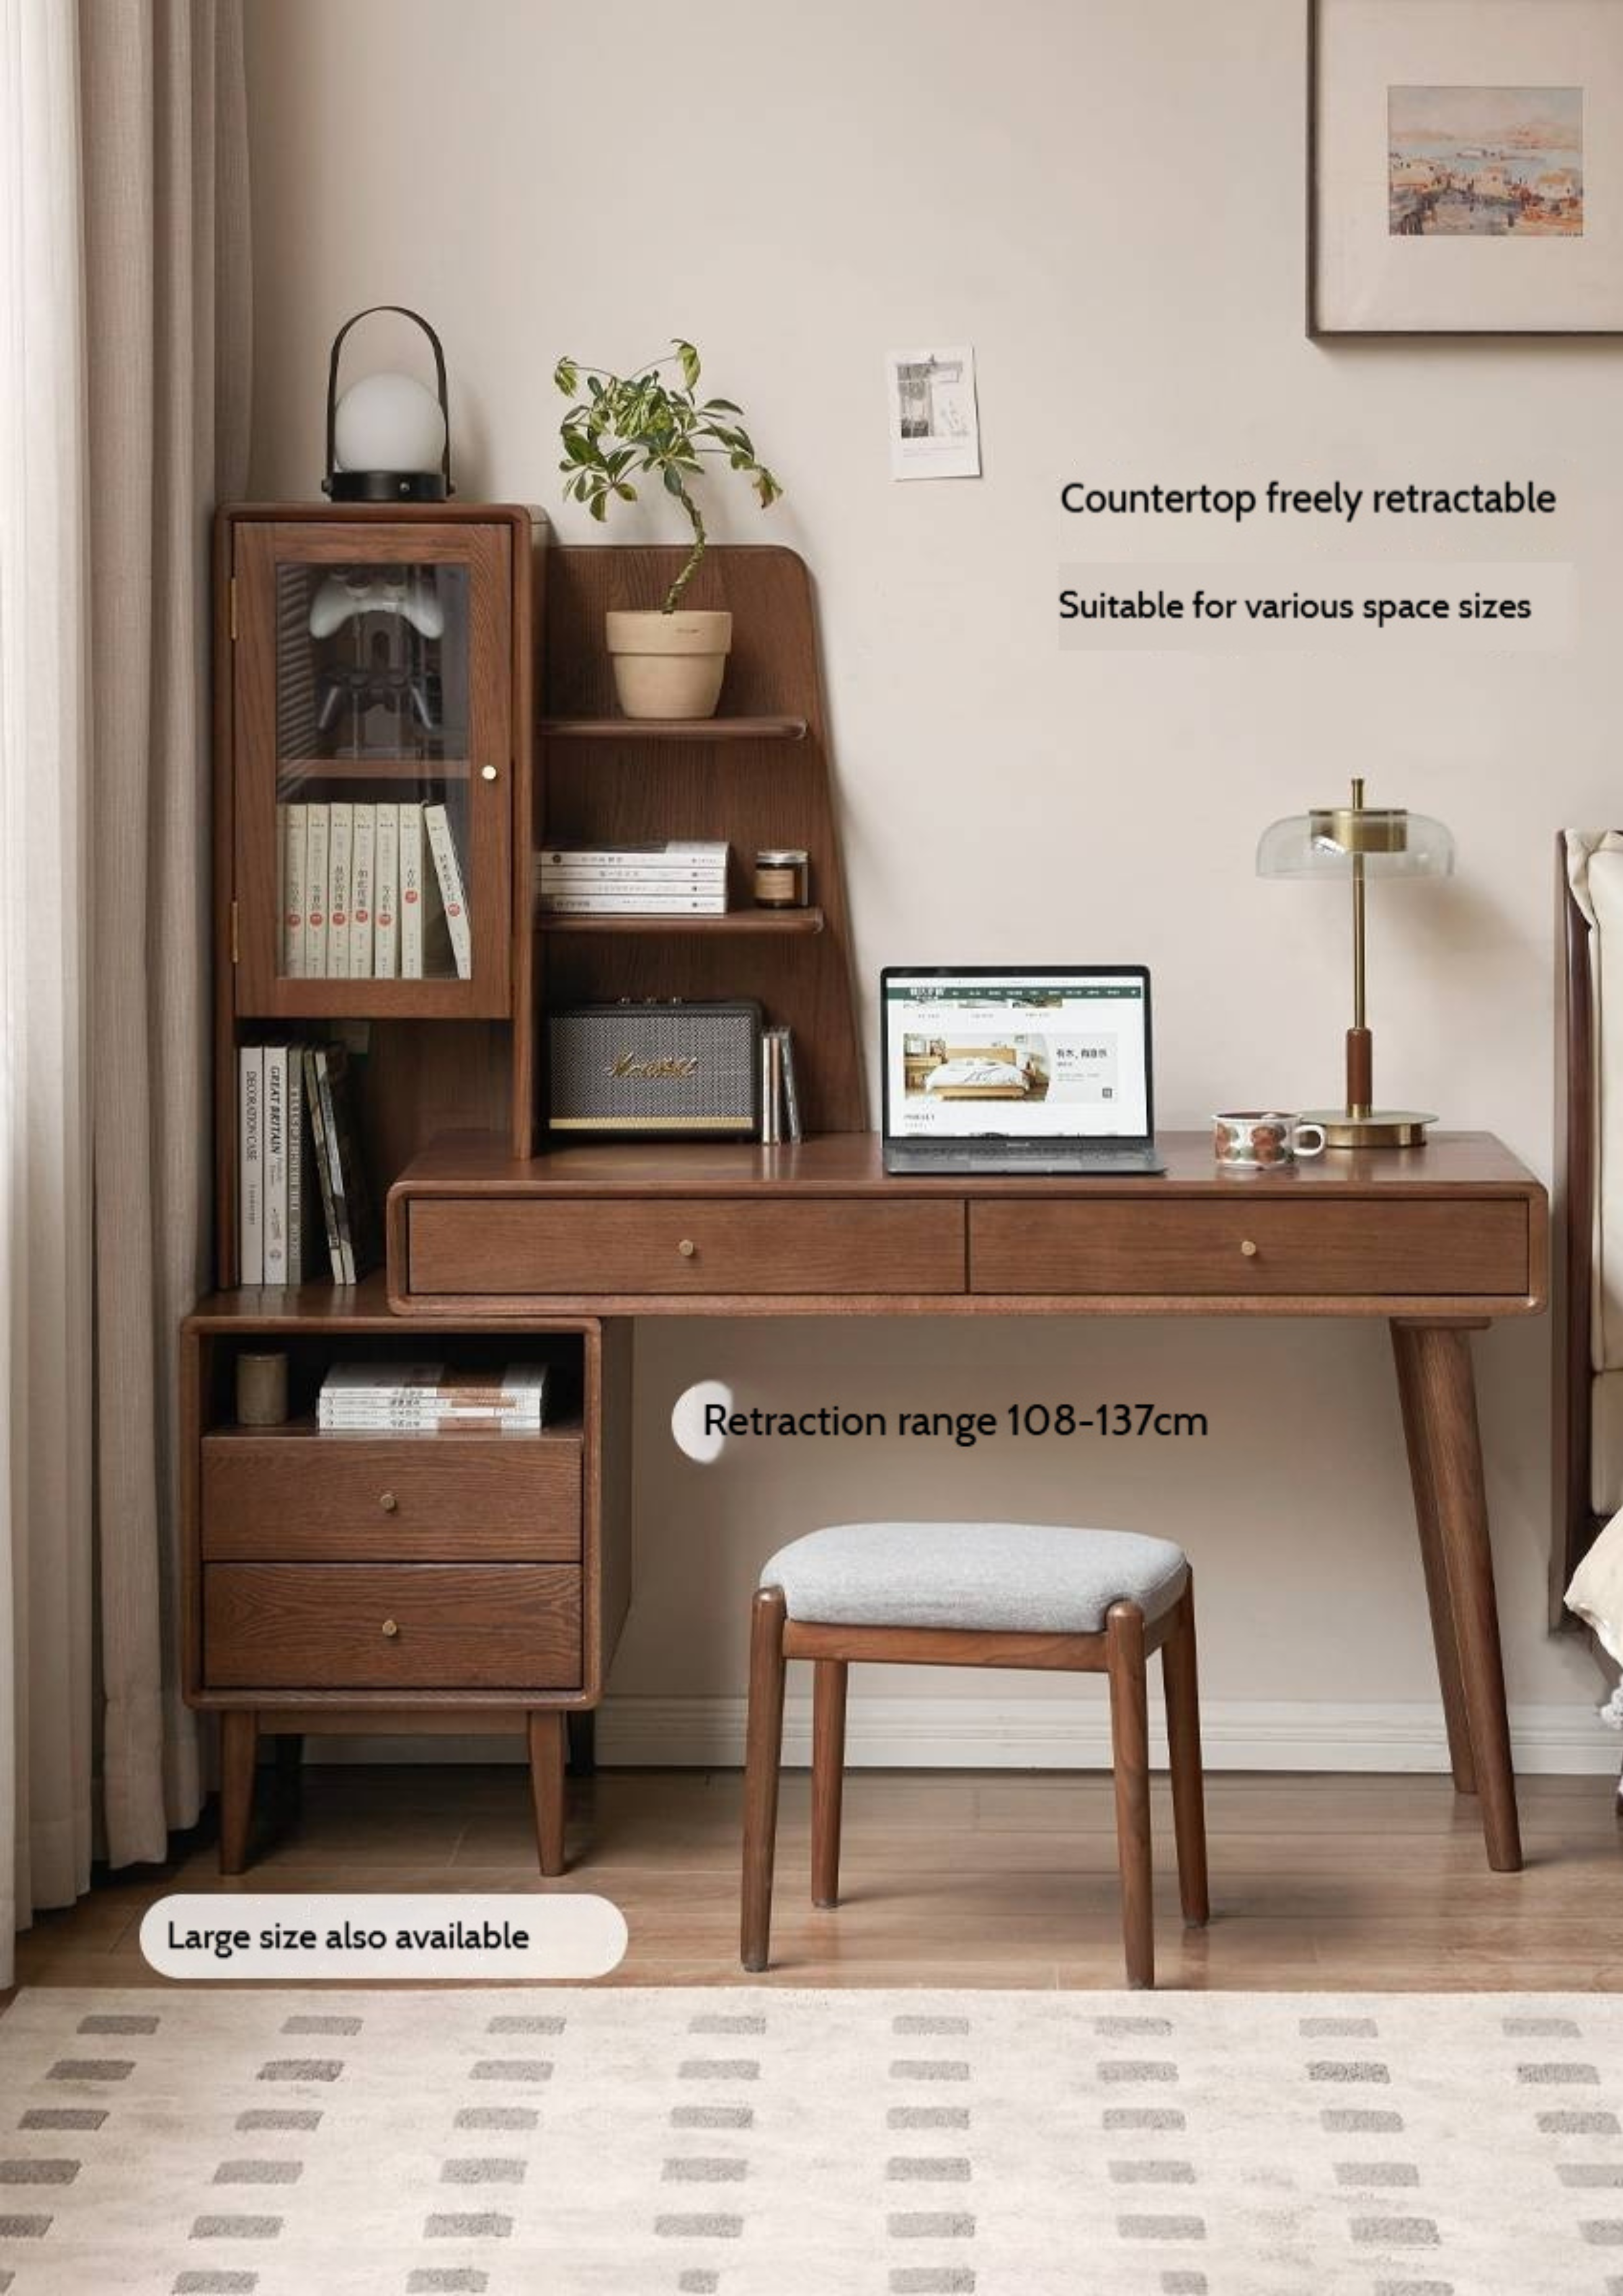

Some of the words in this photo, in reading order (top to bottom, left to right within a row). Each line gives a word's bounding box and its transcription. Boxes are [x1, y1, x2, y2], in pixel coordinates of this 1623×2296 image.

[246, 1071, 258, 1135] DECORATION
[269, 1065, 281, 1105] GREAT
[246, 1136, 258, 1162] CASE
[269, 1106, 282, 1155] BRITAIN
